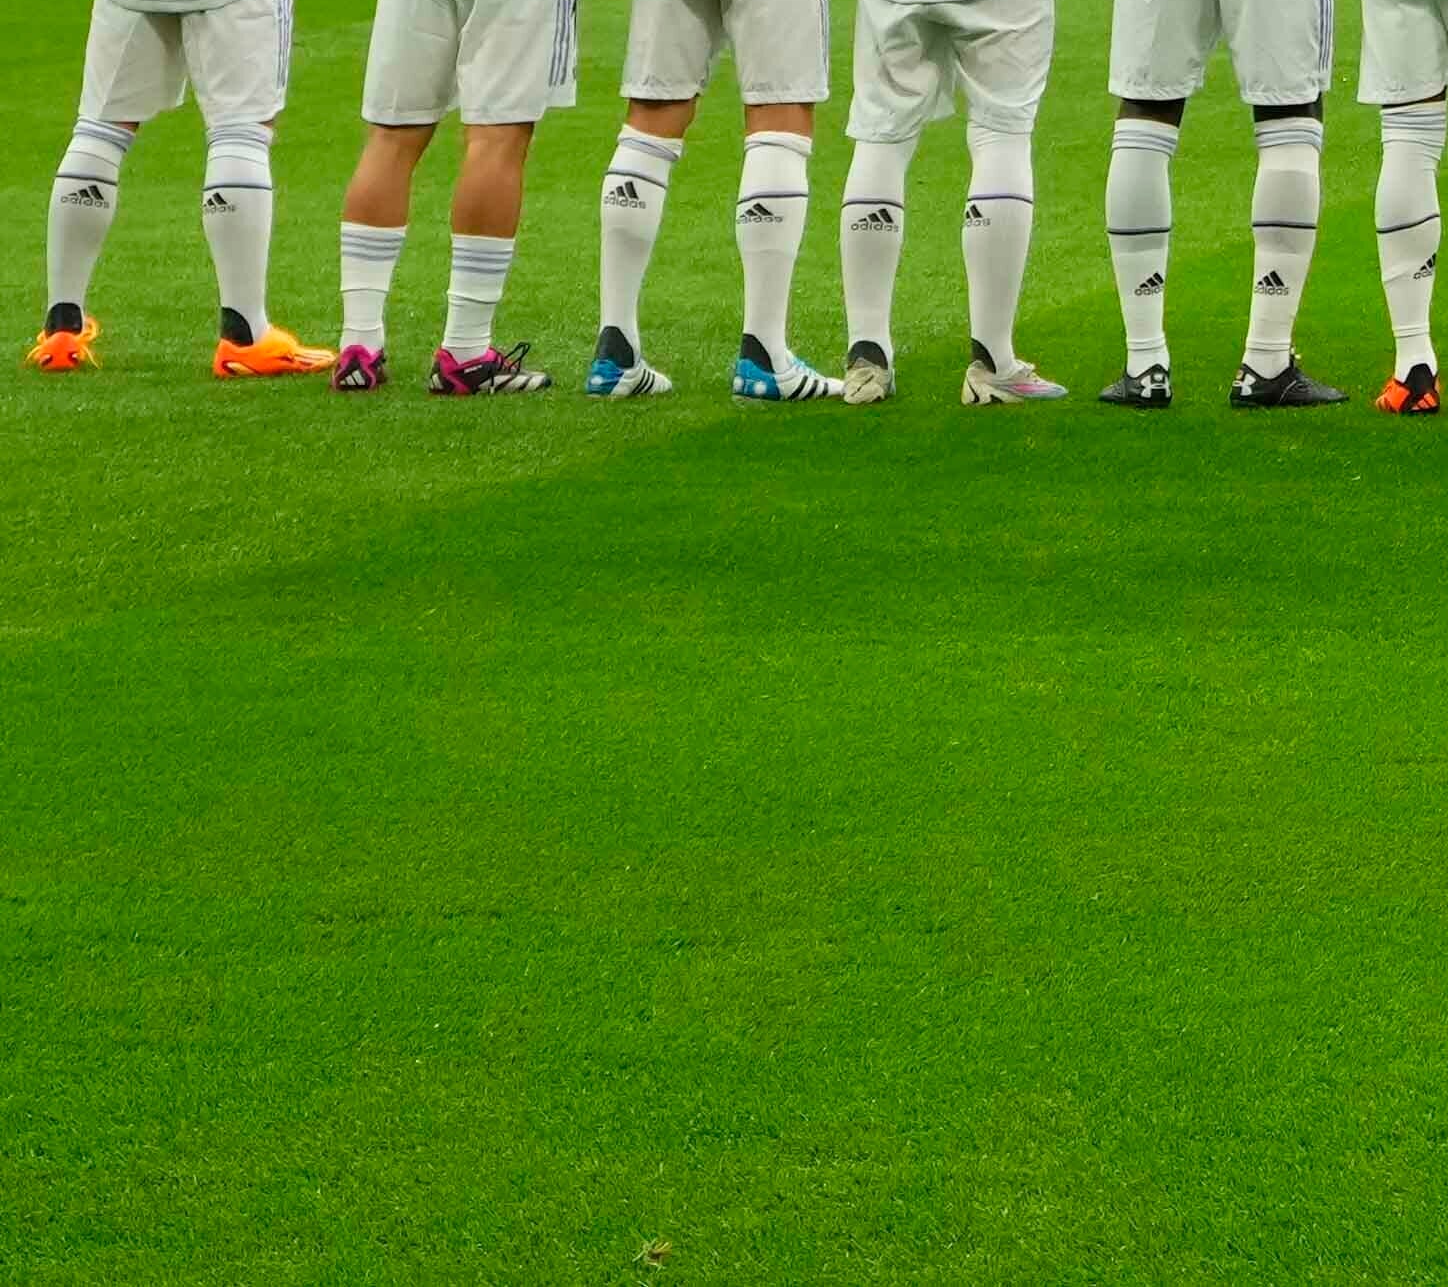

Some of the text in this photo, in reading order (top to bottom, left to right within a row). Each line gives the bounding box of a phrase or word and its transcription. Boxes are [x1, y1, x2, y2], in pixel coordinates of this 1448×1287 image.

[60, 193, 109, 209] adidas
[603, 195, 646, 210] adidas
[851, 221, 900, 233] adidas
